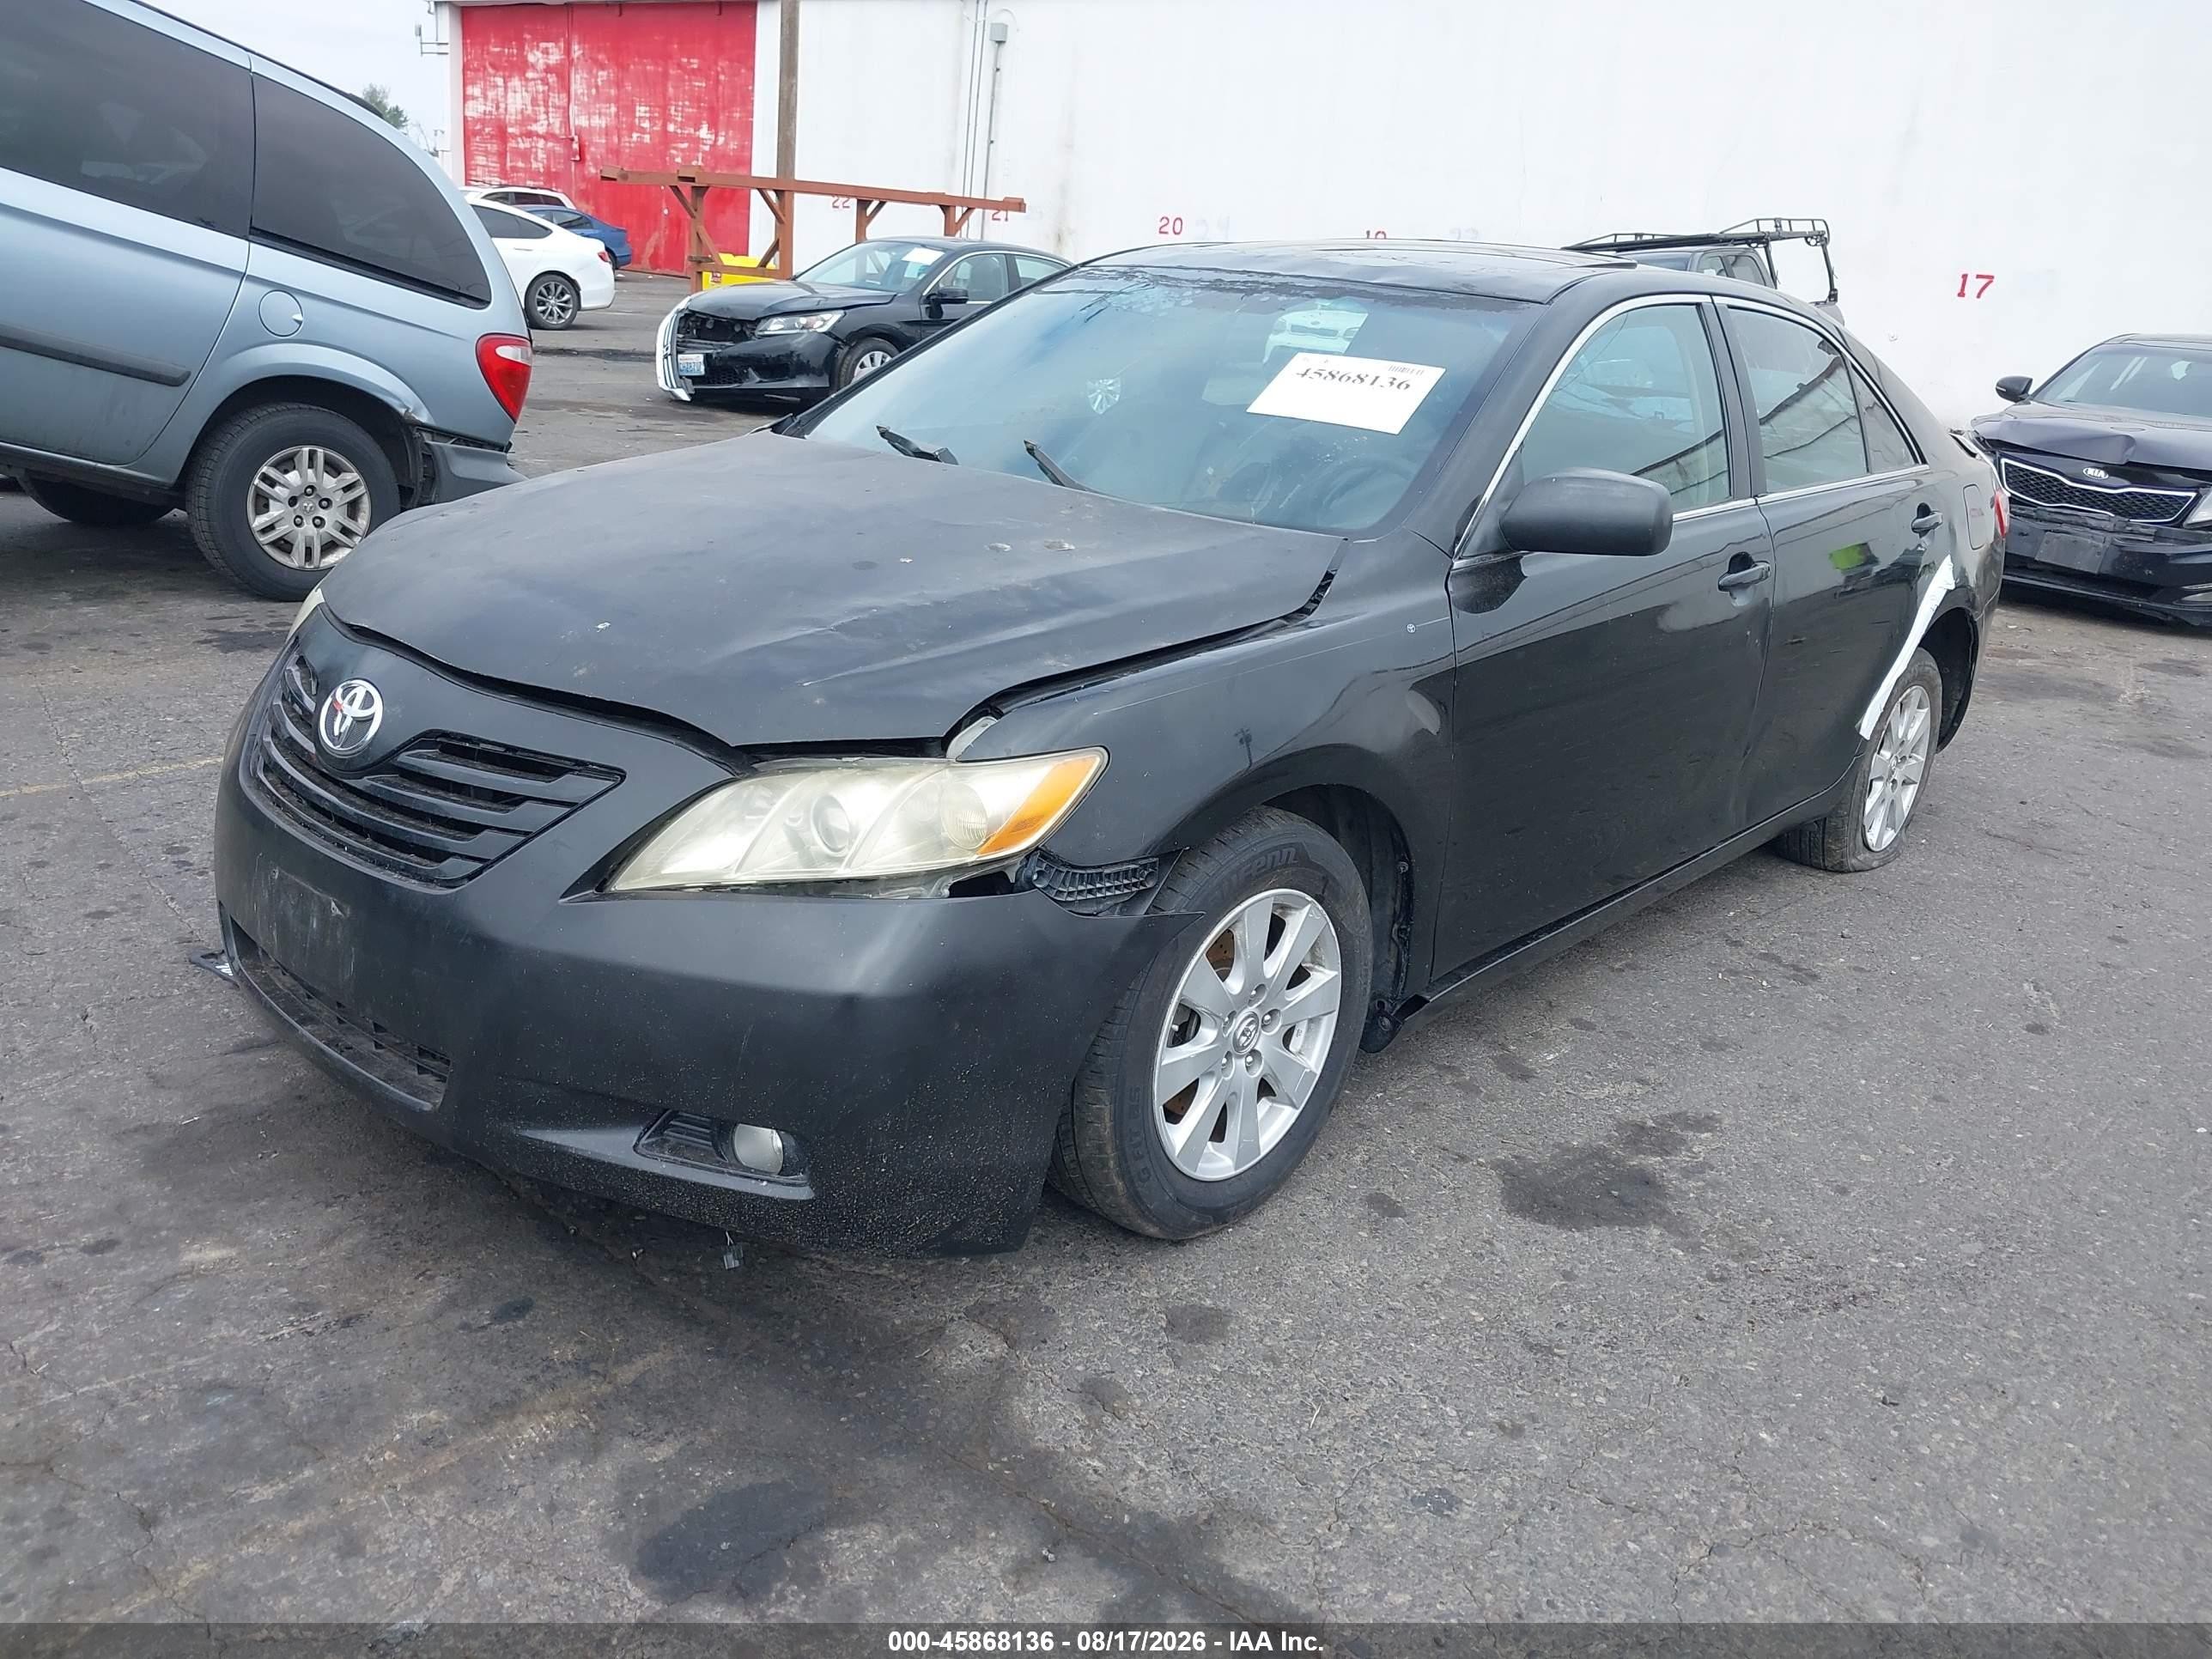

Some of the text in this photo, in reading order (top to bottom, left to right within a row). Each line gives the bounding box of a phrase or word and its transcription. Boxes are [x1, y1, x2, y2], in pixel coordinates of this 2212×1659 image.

[831, 195, 850, 209] 22
[992, 210, 1008, 222] 21
[1158, 216, 1183, 235] 20
[1957, 273, 1995, 299] 17
[1296, 367, 1411, 390] 45868136
